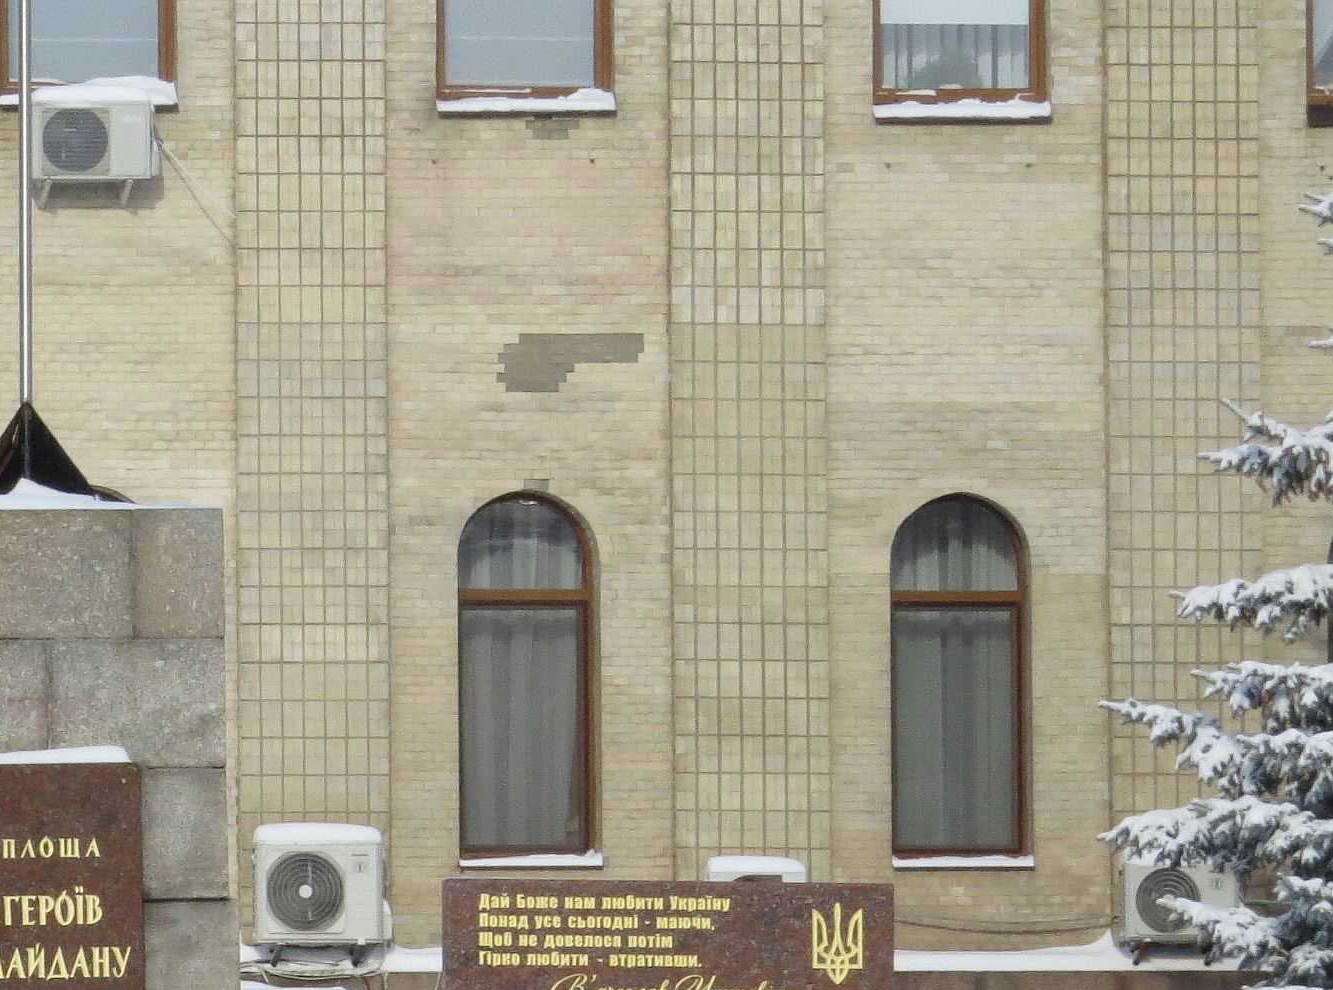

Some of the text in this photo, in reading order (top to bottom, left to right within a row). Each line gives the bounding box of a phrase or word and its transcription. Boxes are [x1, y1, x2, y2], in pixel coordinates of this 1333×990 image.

[2, 835, 101, 859] ПЛОЩА
[2, 886, 103, 927] ГЕРОЇВ
[478, 893, 731, 912] Дай Боже нам любити Україну
[479, 913, 529, 930] Понад
[534, 915, 562, 930] усе
[568, 913, 639, 930] сьогодні
[478, 932, 673, 949] Щоб не довелося потім
[478, 951, 521, 968] Гірко
[527, 952, 589, 968] любити
[609, 953, 703, 968] втративши.
